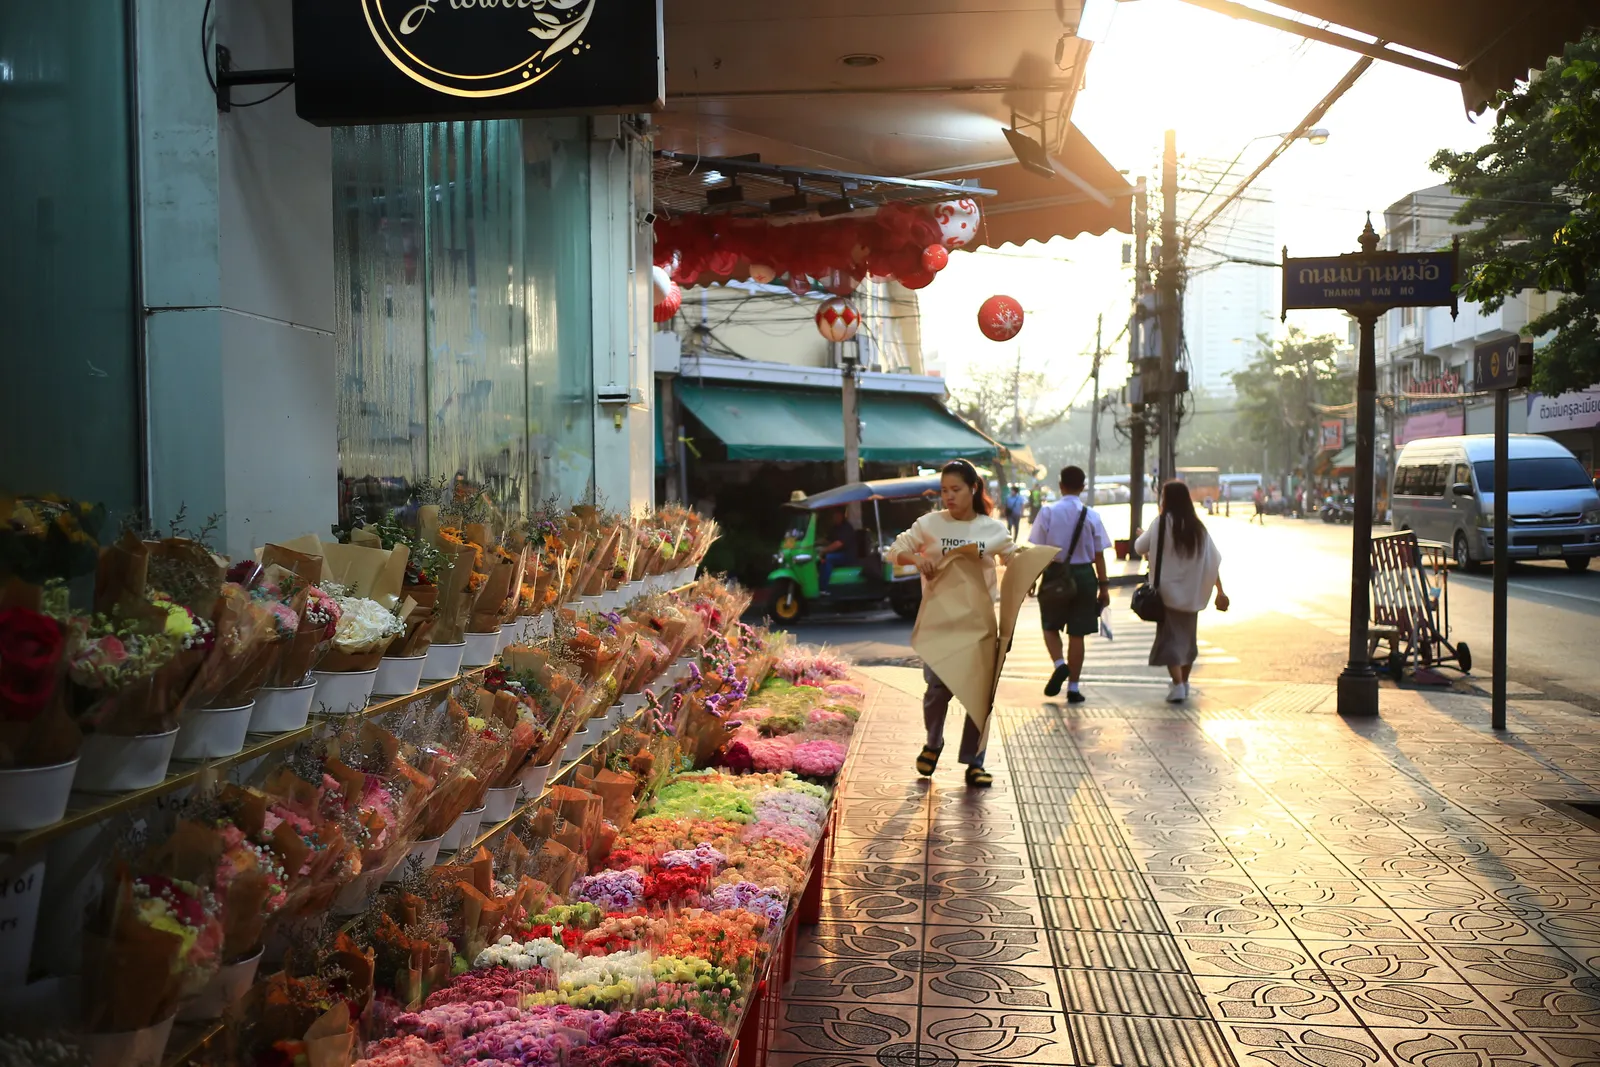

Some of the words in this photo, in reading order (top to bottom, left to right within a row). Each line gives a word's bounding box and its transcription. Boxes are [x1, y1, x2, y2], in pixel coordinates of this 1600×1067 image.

[1299, 258, 1440, 284] ถนนบ้านหม้อ
[1323, 287, 1361, 297] THANON
[1371, 287, 1391, 296] BAN
[1400, 286, 1414, 295] MO
[941, 538, 972, 547] THOS
